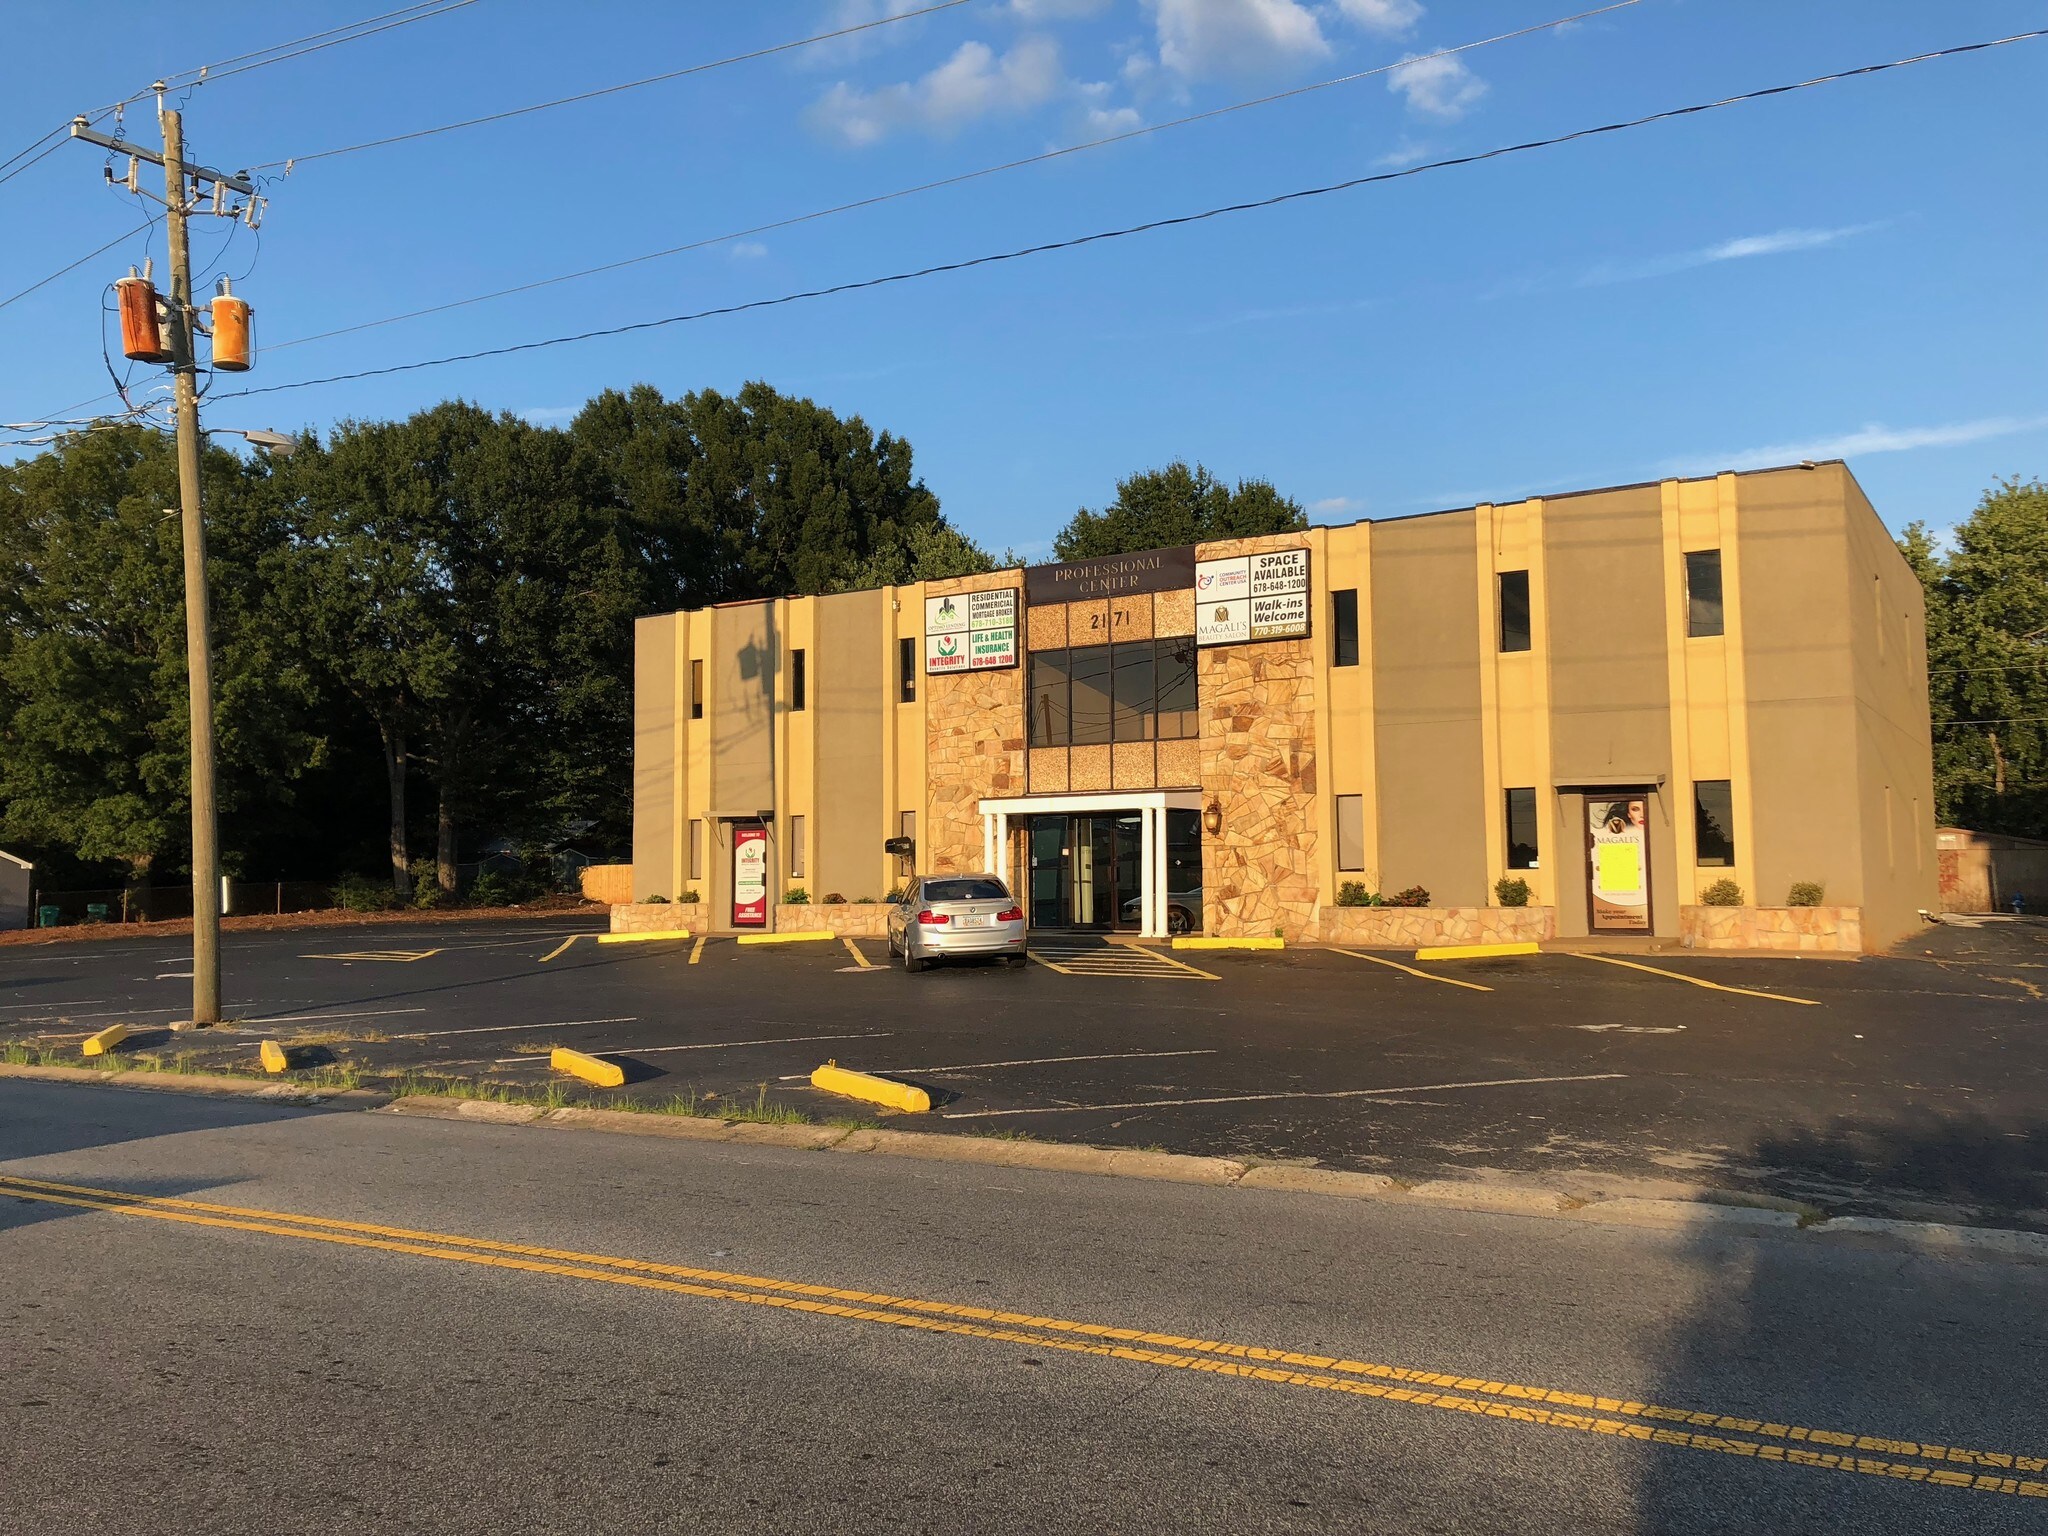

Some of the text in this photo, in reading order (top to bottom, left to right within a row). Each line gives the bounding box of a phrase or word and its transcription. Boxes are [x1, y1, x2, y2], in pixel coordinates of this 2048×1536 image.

[1260, 554, 1298, 568] SPACE
[1055, 556, 1164, 581] PROFESSIONAL
[1254, 565, 1305, 581] AVAILABLE
[1079, 575, 1139, 593] CENTER
[1219, 574, 1247, 582] OUTREACH
[1253, 578, 1306, 593] 678-648-1200
[972, 590, 1013, 602] RESIDENTIAL
[972, 599, 1013, 611] COMMERICIAL
[1255, 598, 1303, 612] Walk-ins
[972, 608, 1013, 619] MORTGAGE BROKER
[1091, 610, 1130, 630] 2171
[1254, 610, 1305, 623] Welcome
[1199, 621, 1247, 635] MAGALI'S
[972, 633, 983, 643] LIFE
[990, 630, 1013, 641] HEALTH
[1199, 631, 1247, 642] BEAUTY SALON
[975, 642, 1009, 654] INSURANCE
[929, 655, 965, 667] INTEGRITY
[1597, 836, 1640, 844] MAGALI'S
